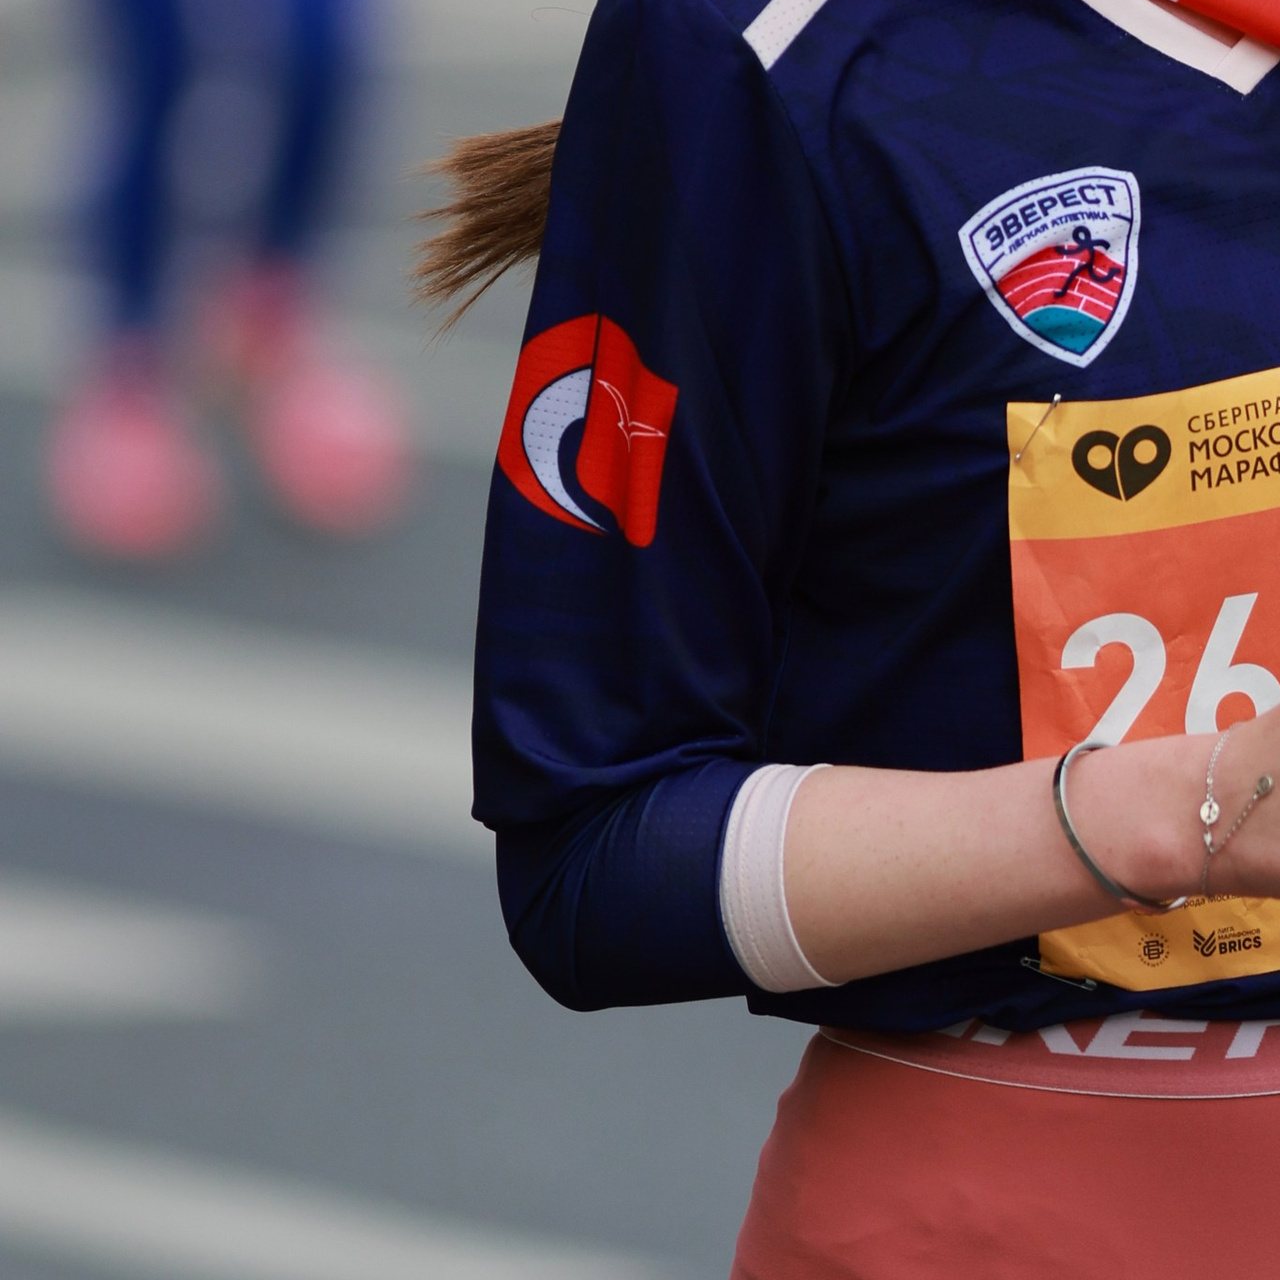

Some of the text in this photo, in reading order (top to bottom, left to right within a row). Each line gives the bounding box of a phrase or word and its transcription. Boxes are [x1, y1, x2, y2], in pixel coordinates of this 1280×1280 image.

[984, 183, 1116, 252] ЭВЕРЕСТ
[1050, 210, 1110, 229] АТЛЕТИКА
[1217, 926, 1235, 934] ЛИГА
[1217, 928, 1261, 940] МАРАФОНОВ
[1218, 936, 1262, 955] BRICS
